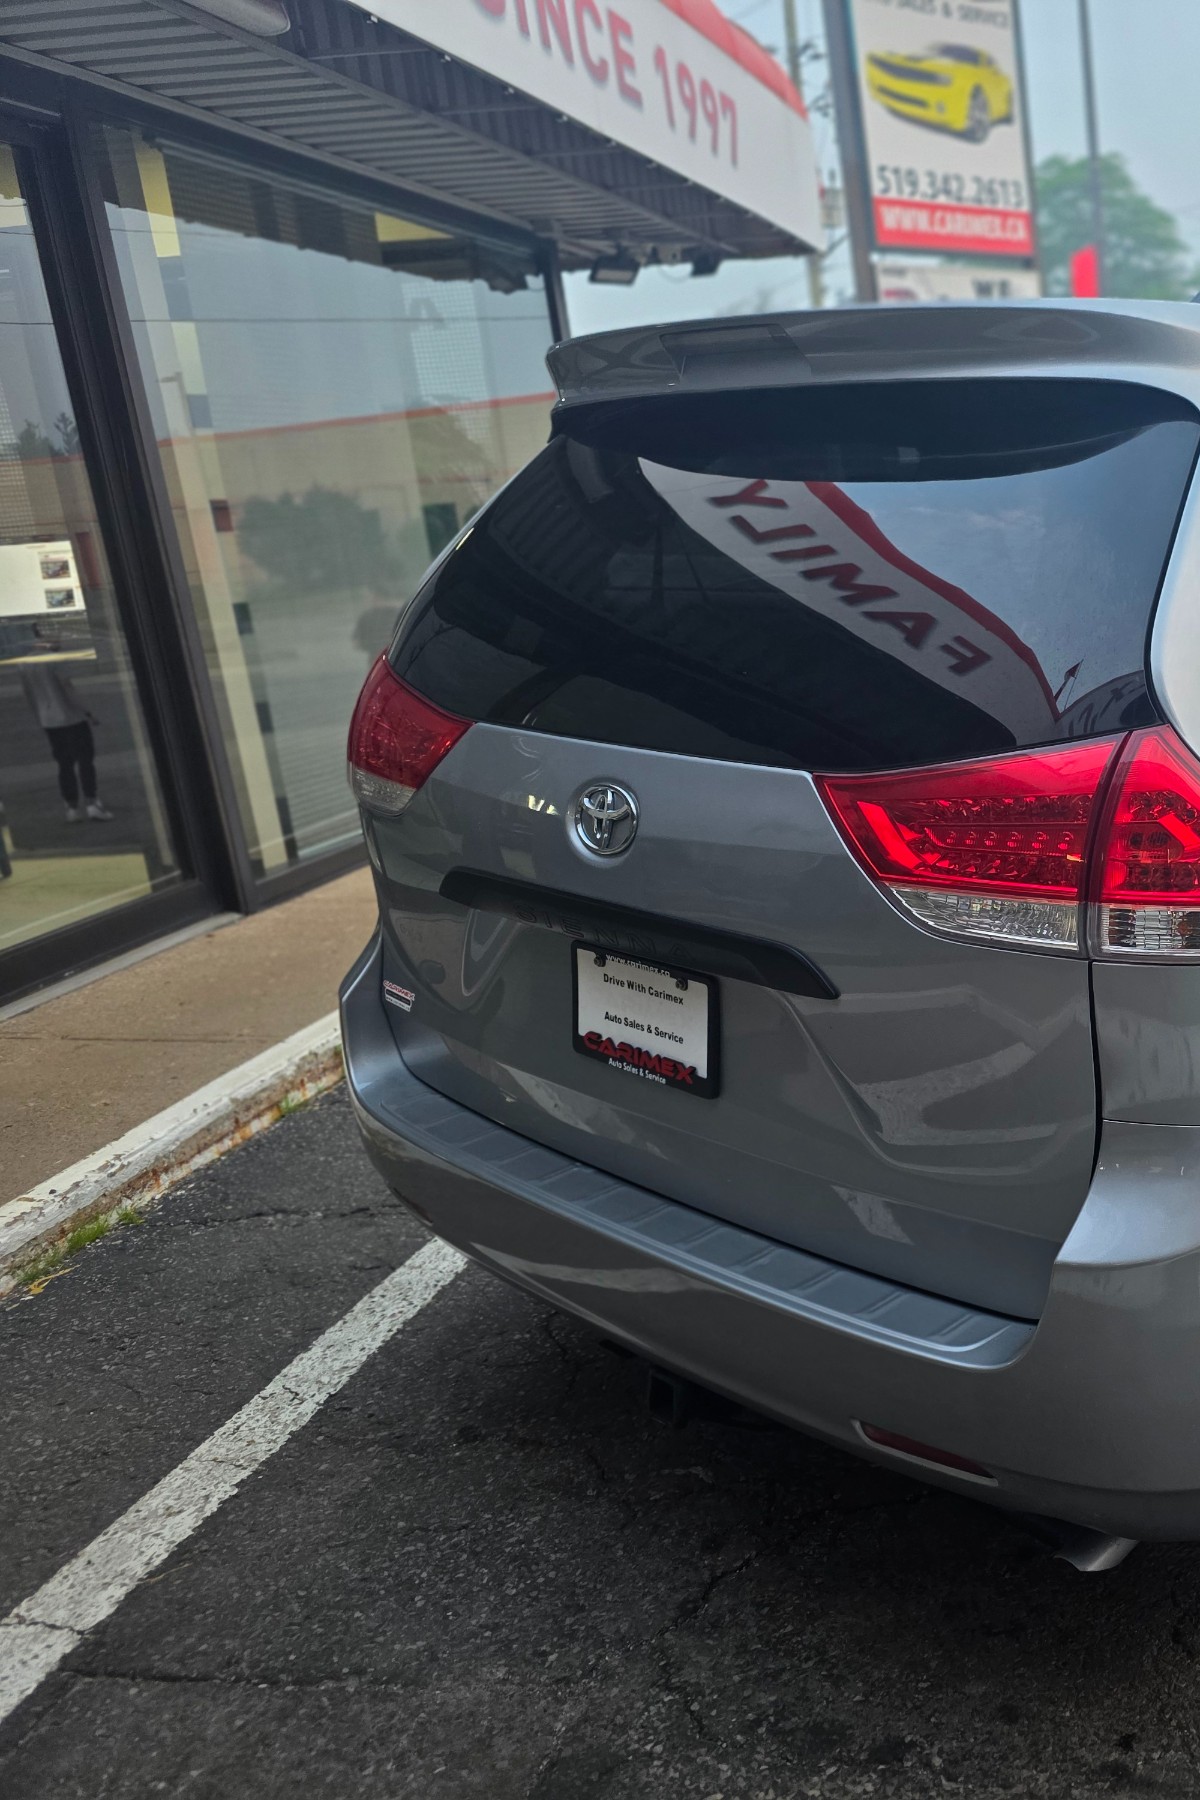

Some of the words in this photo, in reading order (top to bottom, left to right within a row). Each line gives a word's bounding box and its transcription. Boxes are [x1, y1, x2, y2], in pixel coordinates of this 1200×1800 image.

[471, 0, 643, 111] NCE
[654, 44, 737, 169] 1997
[876, 165, 1024, 209] 519.342.2613
[513, 905, 694, 961] SIENNA
[603, 973, 626, 988] Drive
[626, 980, 647, 994] With
[648, 986, 684, 1005] Carimex
[604, 1011, 622, 1025] Auto
[623, 1017, 645, 1032] Sales
[646, 1024, 653, 1034] &
[654, 1026, 684, 1044] Service
[583, 1031, 696, 1084] CARIMEX
[608, 1057, 622, 1069] Auto
[623, 1063, 639, 1076] Sales
[639, 1067, 645, 1077] &
[645, 1071, 667, 1085] Service
